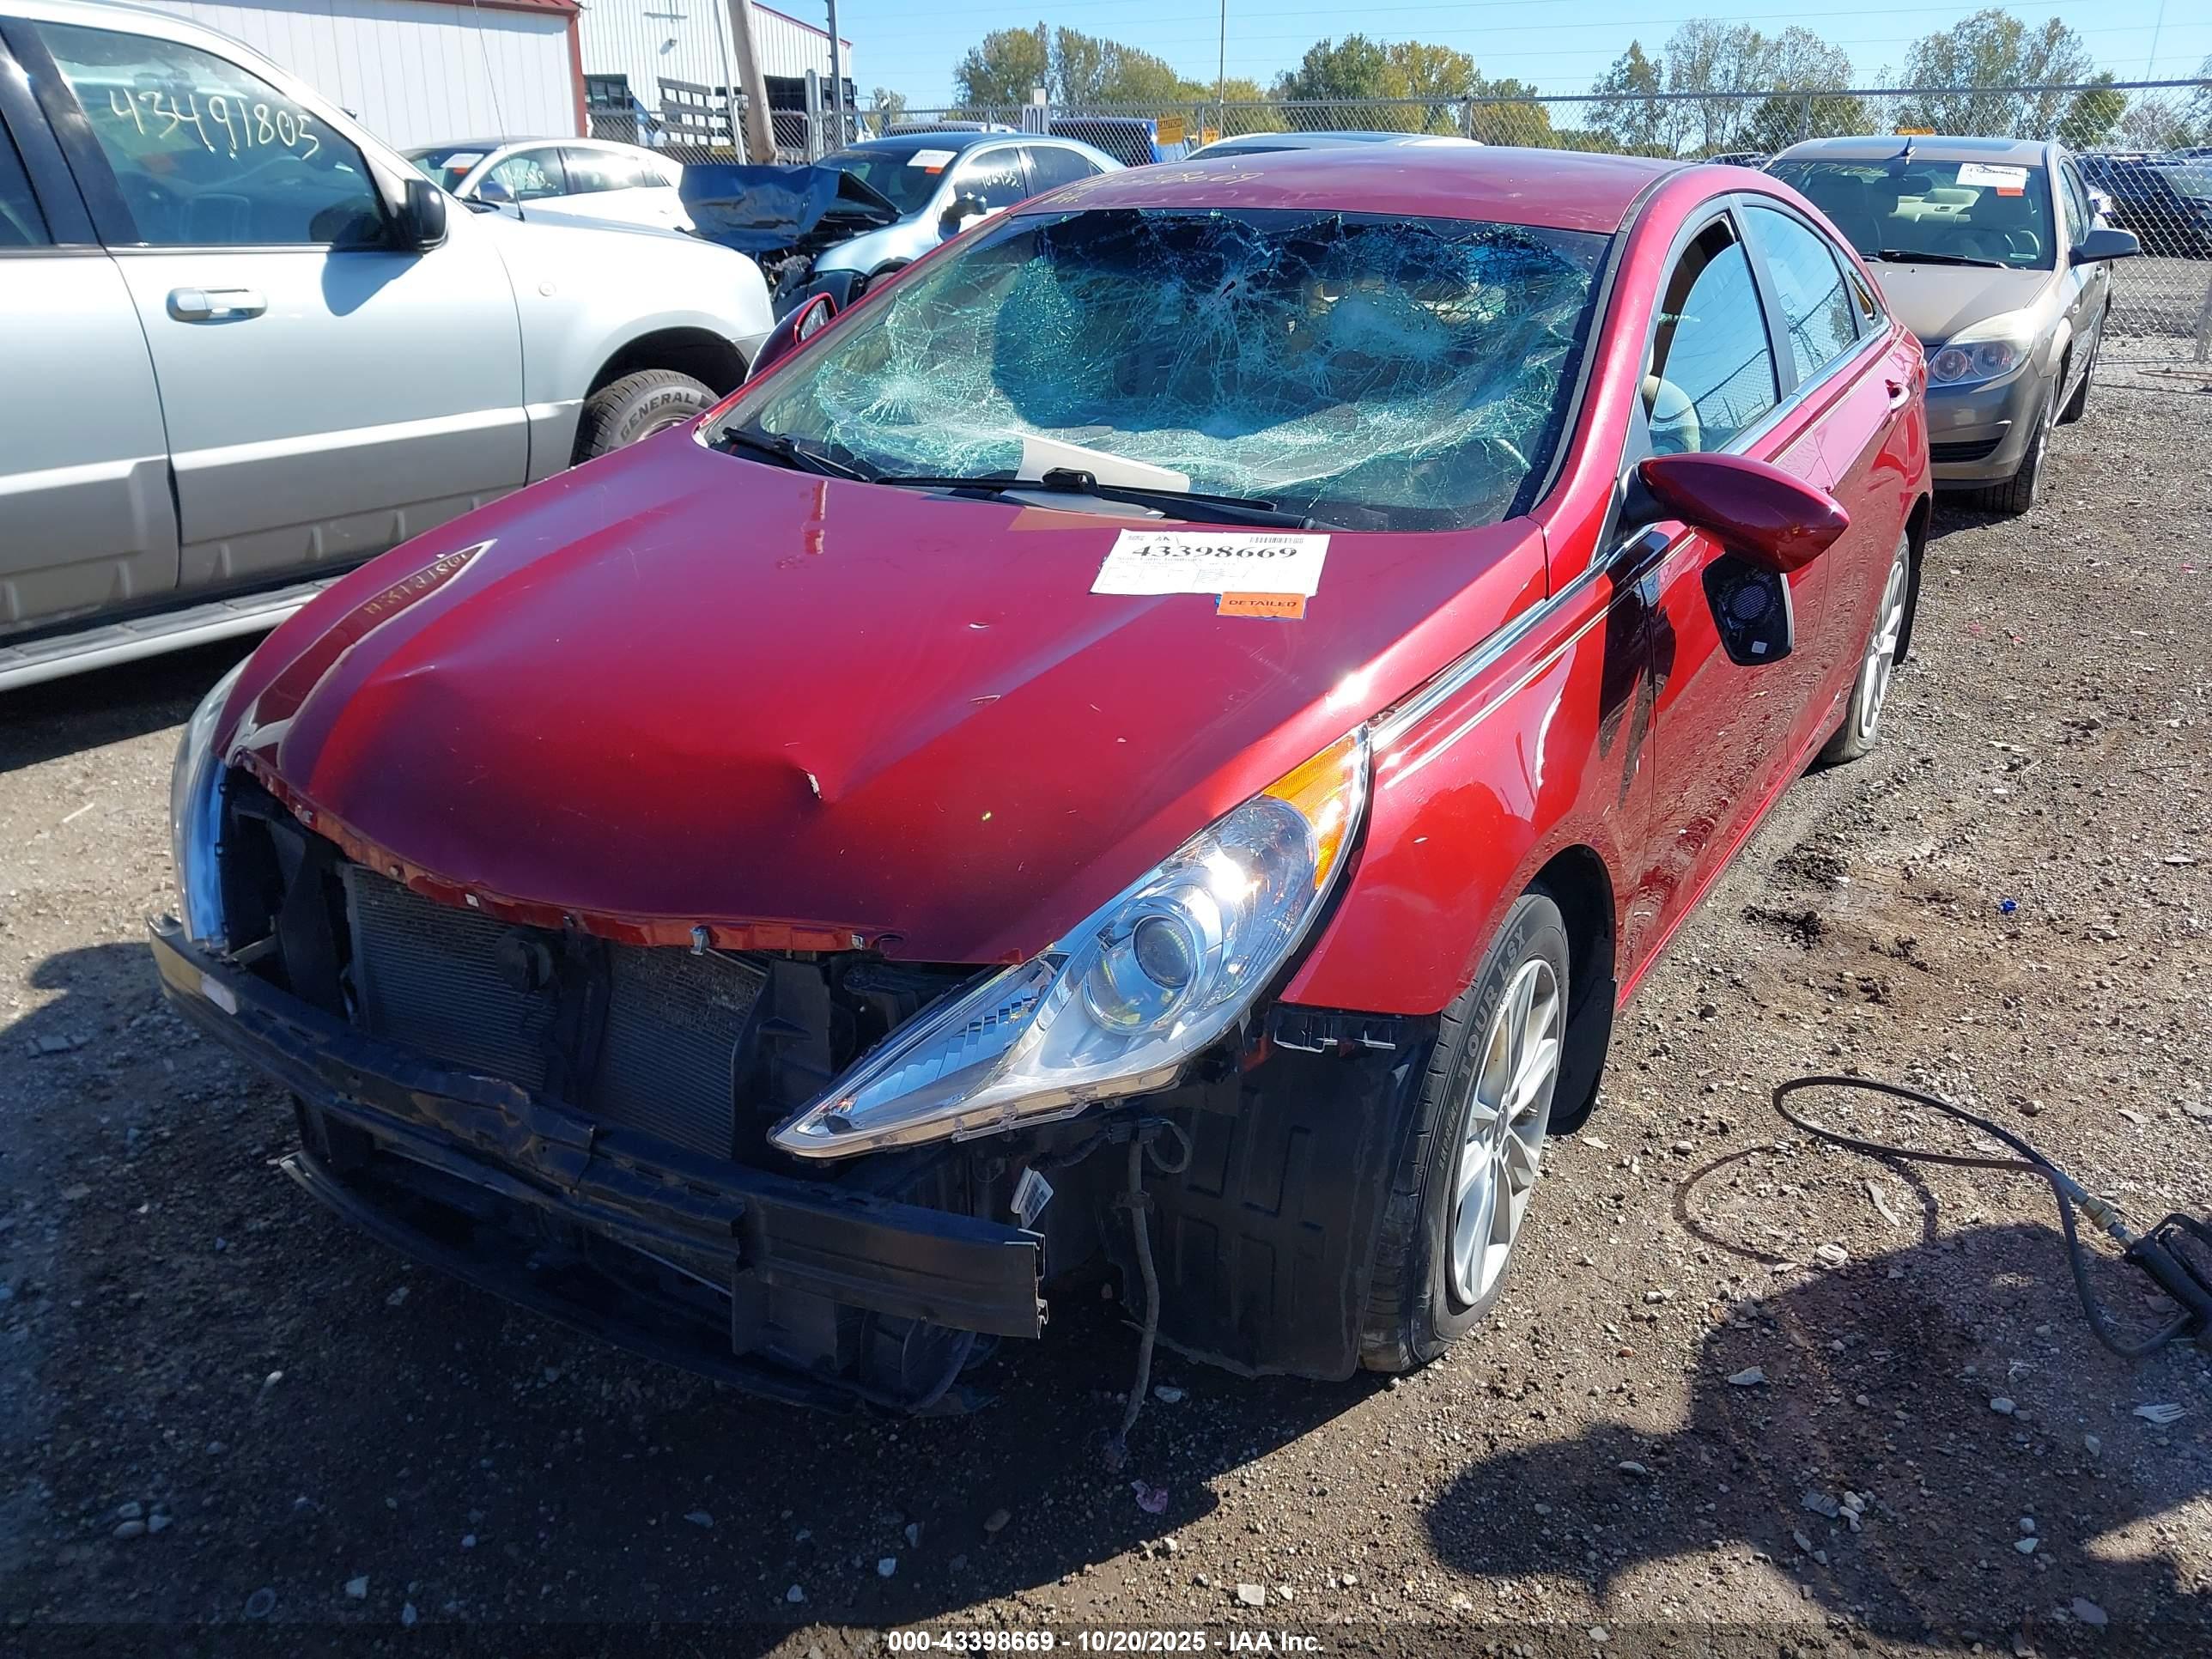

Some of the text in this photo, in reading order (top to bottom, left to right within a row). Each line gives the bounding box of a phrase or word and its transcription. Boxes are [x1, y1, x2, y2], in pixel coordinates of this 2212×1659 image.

[109, 88, 319, 161] 43491805
[620, 392, 694, 441] GENERAL
[1132, 545, 1297, 558] 43398669
[1229, 599, 1297, 608] DETAILED
[1459, 985, 1498, 1078] TOUR
[1498, 925, 1526, 979] LSX
